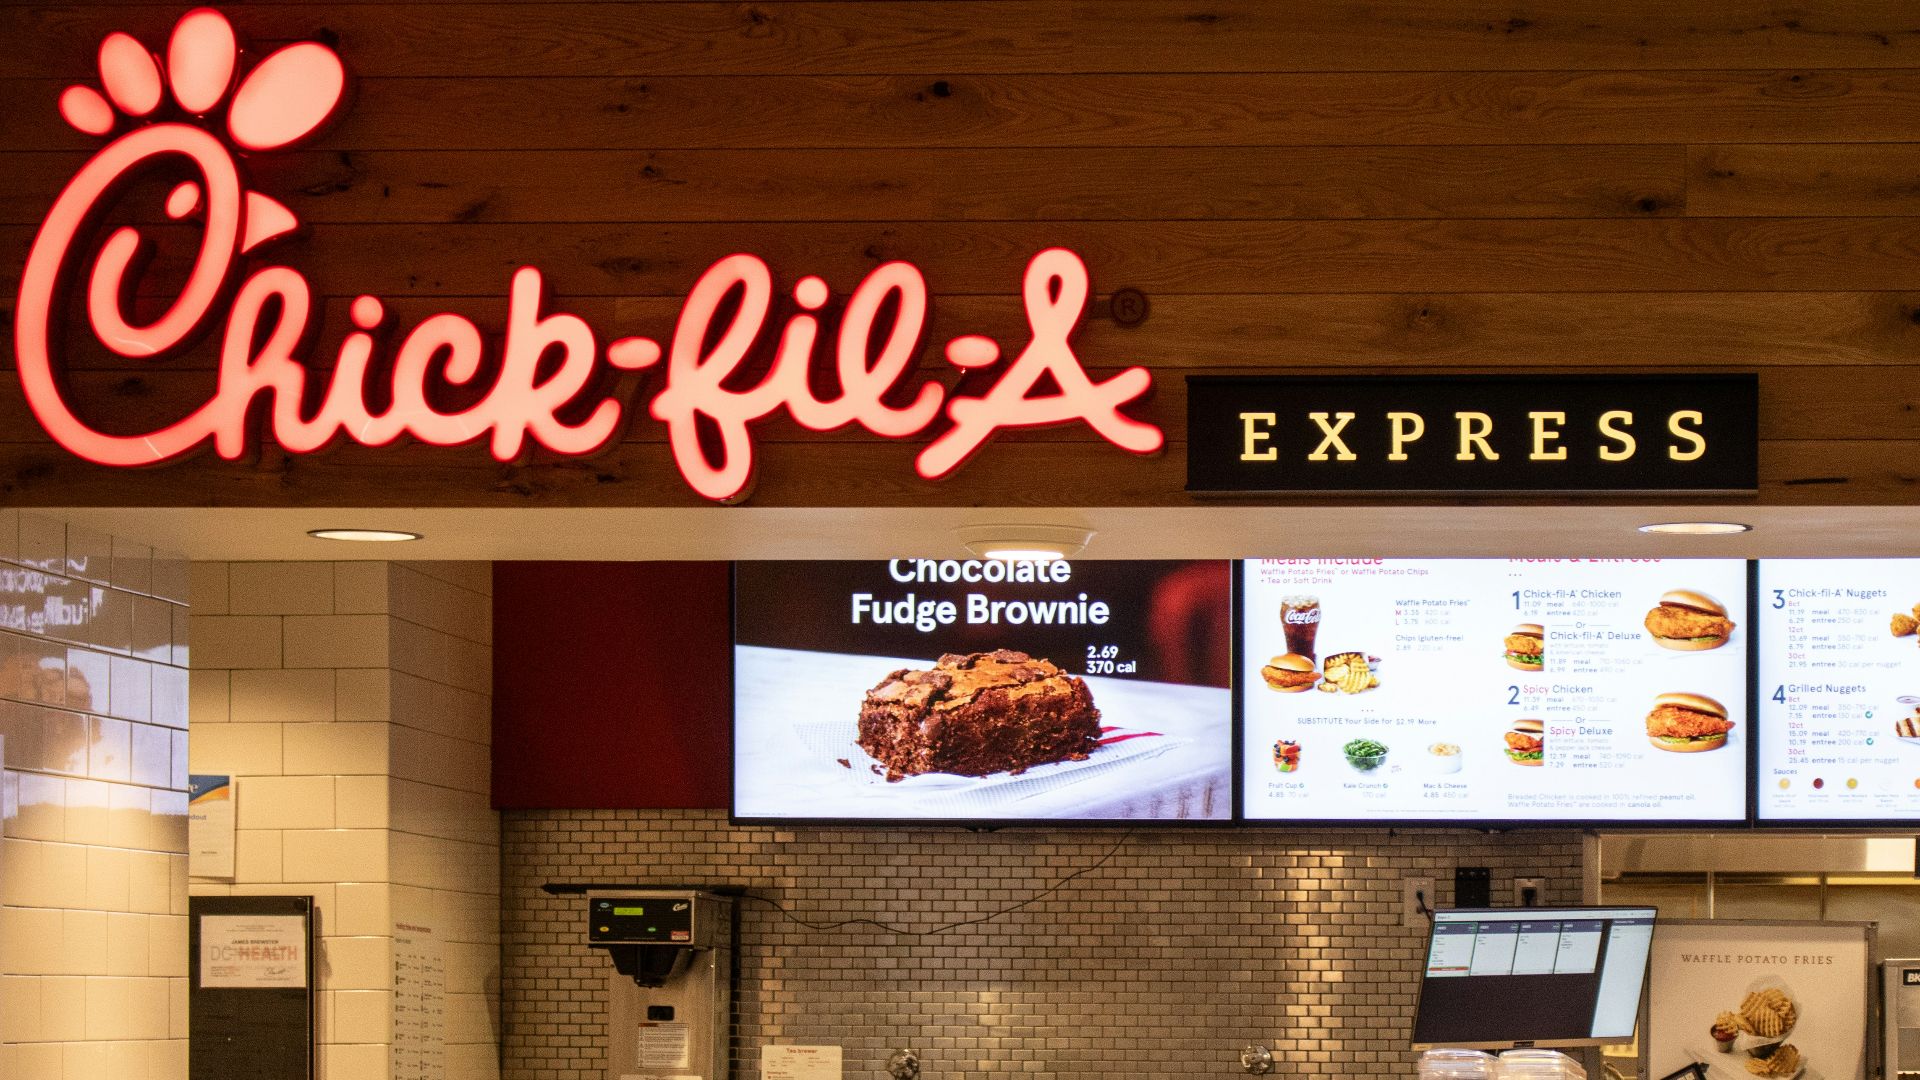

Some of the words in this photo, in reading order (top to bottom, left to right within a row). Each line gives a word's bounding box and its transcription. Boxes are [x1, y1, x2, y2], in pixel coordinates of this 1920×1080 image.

[14, 122, 1164, 499] Chick-fil-A
[1239, 410, 1706, 462] EXPRESS
[889, 559, 1072, 583] Chocolate
[1261, 568, 1286, 576] Waffle
[1288, 568, 1314, 576] Potato
[1340, 568, 1350, 576] or
[1351, 568, 1377, 576] Waffle
[1378, 568, 1405, 576] Potato
[1406, 568, 1429, 578] Chips
[1512, 590, 1520, 610] 1
[1580, 589, 1622, 599] Chicken
[1772, 589, 1786, 610] 3
[1846, 589, 1888, 600] Nuggets
[852, 593, 957, 633] Fudge
[966, 592, 1110, 625] Brownie
[1395, 634, 1417, 642] Chips
[1418, 634, 1464, 642] (gluten-free)
[1608, 631, 1642, 640] Deluxe
[1087, 646, 1119, 659] 2.69
[1086, 661, 1114, 674] 370
[1116, 660, 1137, 673] cal
[1507, 685, 1520, 705] 2
[1523, 685, 1550, 694] Spicy
[1552, 685, 1593, 694] Chicken
[1772, 685, 1786, 705] 4
[1788, 684, 1822, 693] Grilled
[1825, 684, 1866, 695] Nuggets
[1550, 727, 1576, 736] Spicy
[1579, 727, 1613, 735] Deluxe
[1285, 782, 1298, 790] Cup
[1659, 794, 1684, 802] peanut
[210, 946, 233, 961] DC
[239, 946, 297, 961] HEALTH
[1682, 954, 1731, 963] WAFFLE
[1738, 954, 1788, 964] POTATO
[1794, 955, 1833, 965] FRIES
